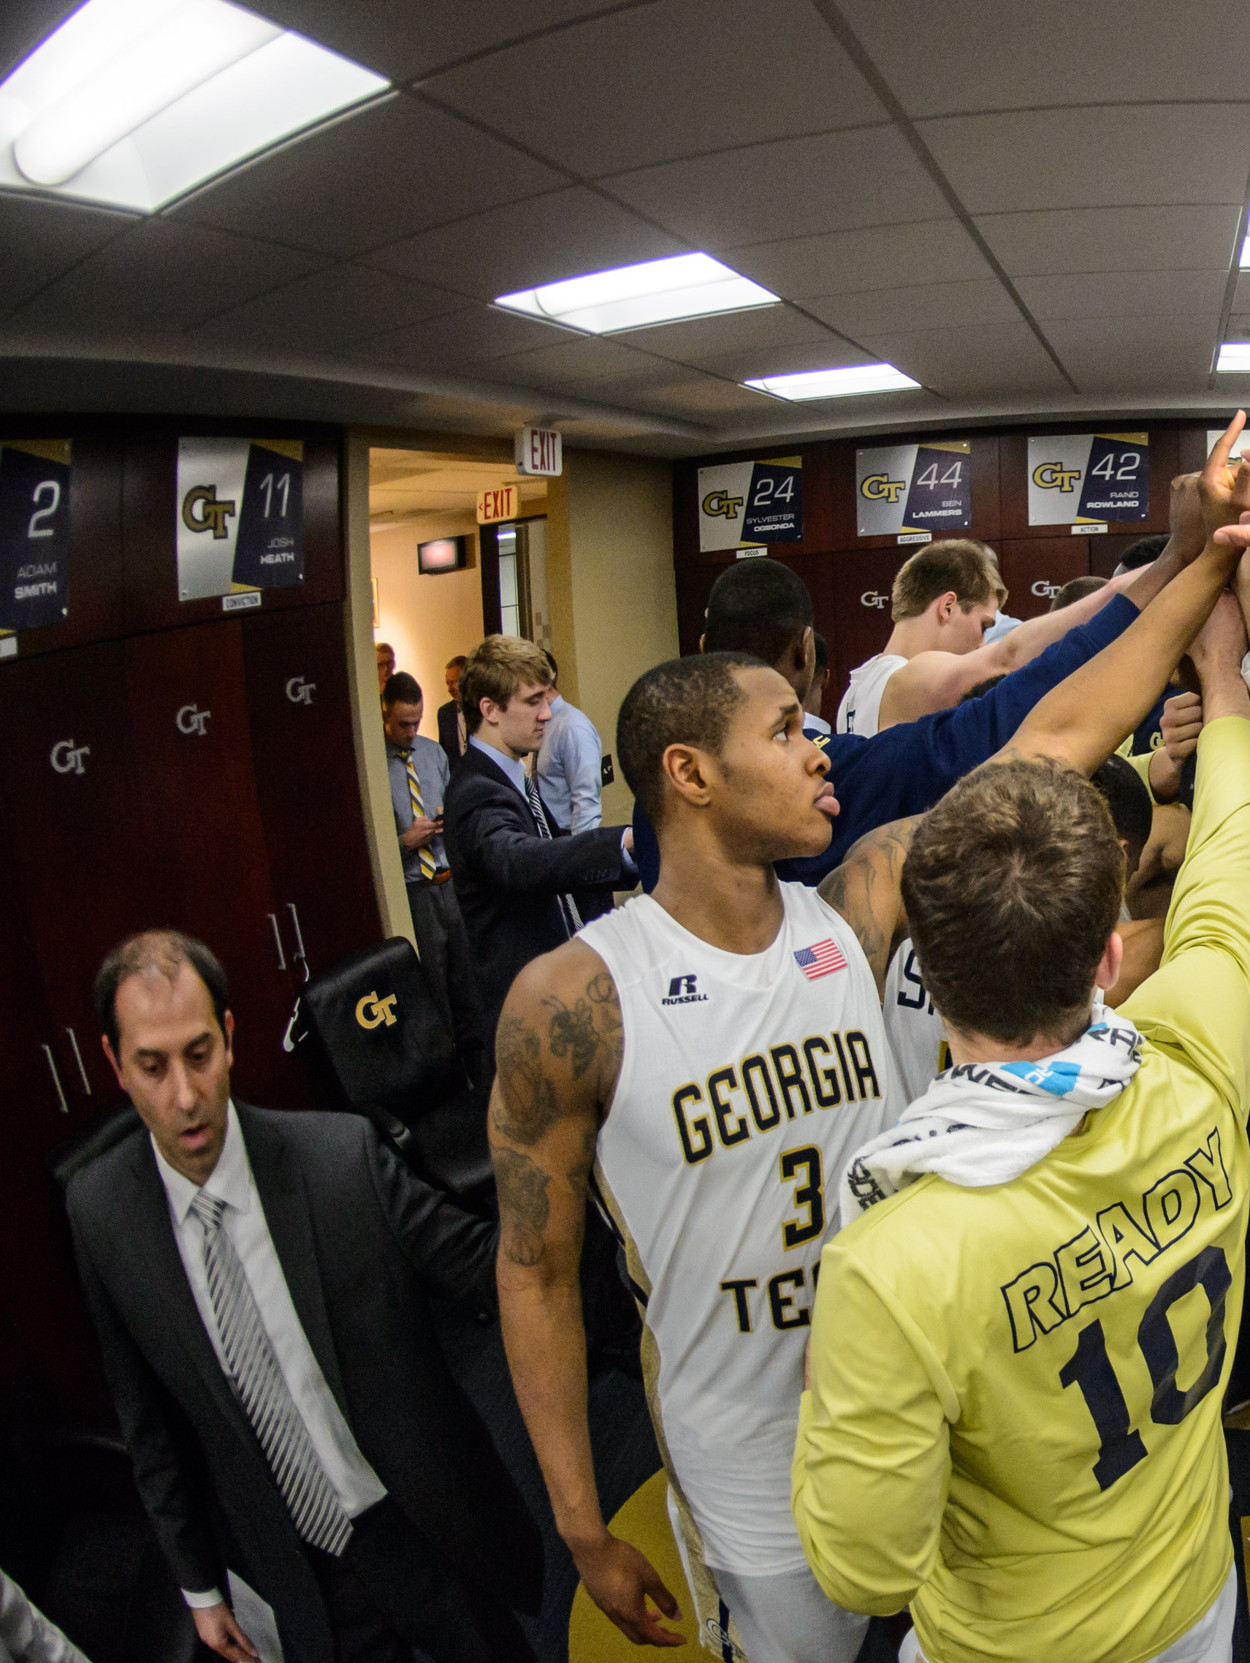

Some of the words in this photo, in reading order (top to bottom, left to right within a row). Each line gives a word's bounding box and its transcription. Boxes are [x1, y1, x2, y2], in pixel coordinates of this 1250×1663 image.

[531, 430, 557, 471] EXIT
[917, 461, 962, 490] 44
[1033, 462, 1080, 492] GT
[1091, 453, 1140, 480] 42
[260, 473, 291, 518] 11
[754, 476, 794, 506] 24
[861, 473, 906, 503] GT
[27, 480, 61, 538] 2
[182, 484, 236, 540] GT
[484, 488, 512, 520] EXIT
[702, 490, 744, 519] GT
[746, 513, 795, 524] SYLVESTER
[912, 509, 962, 518] LAMMERS
[260, 552, 295, 564] HEATH
[14, 582, 57, 600] SMITH
[661, 993, 709, 1006] RUSSELL
[671, 1028, 882, 1167] GEORGIA
[780, 1143, 826, 1252] 3
[1000, 1126, 1233, 1354] READY
[719, 1260, 821, 1334] TE
[1058, 1245, 1232, 1493] 10
